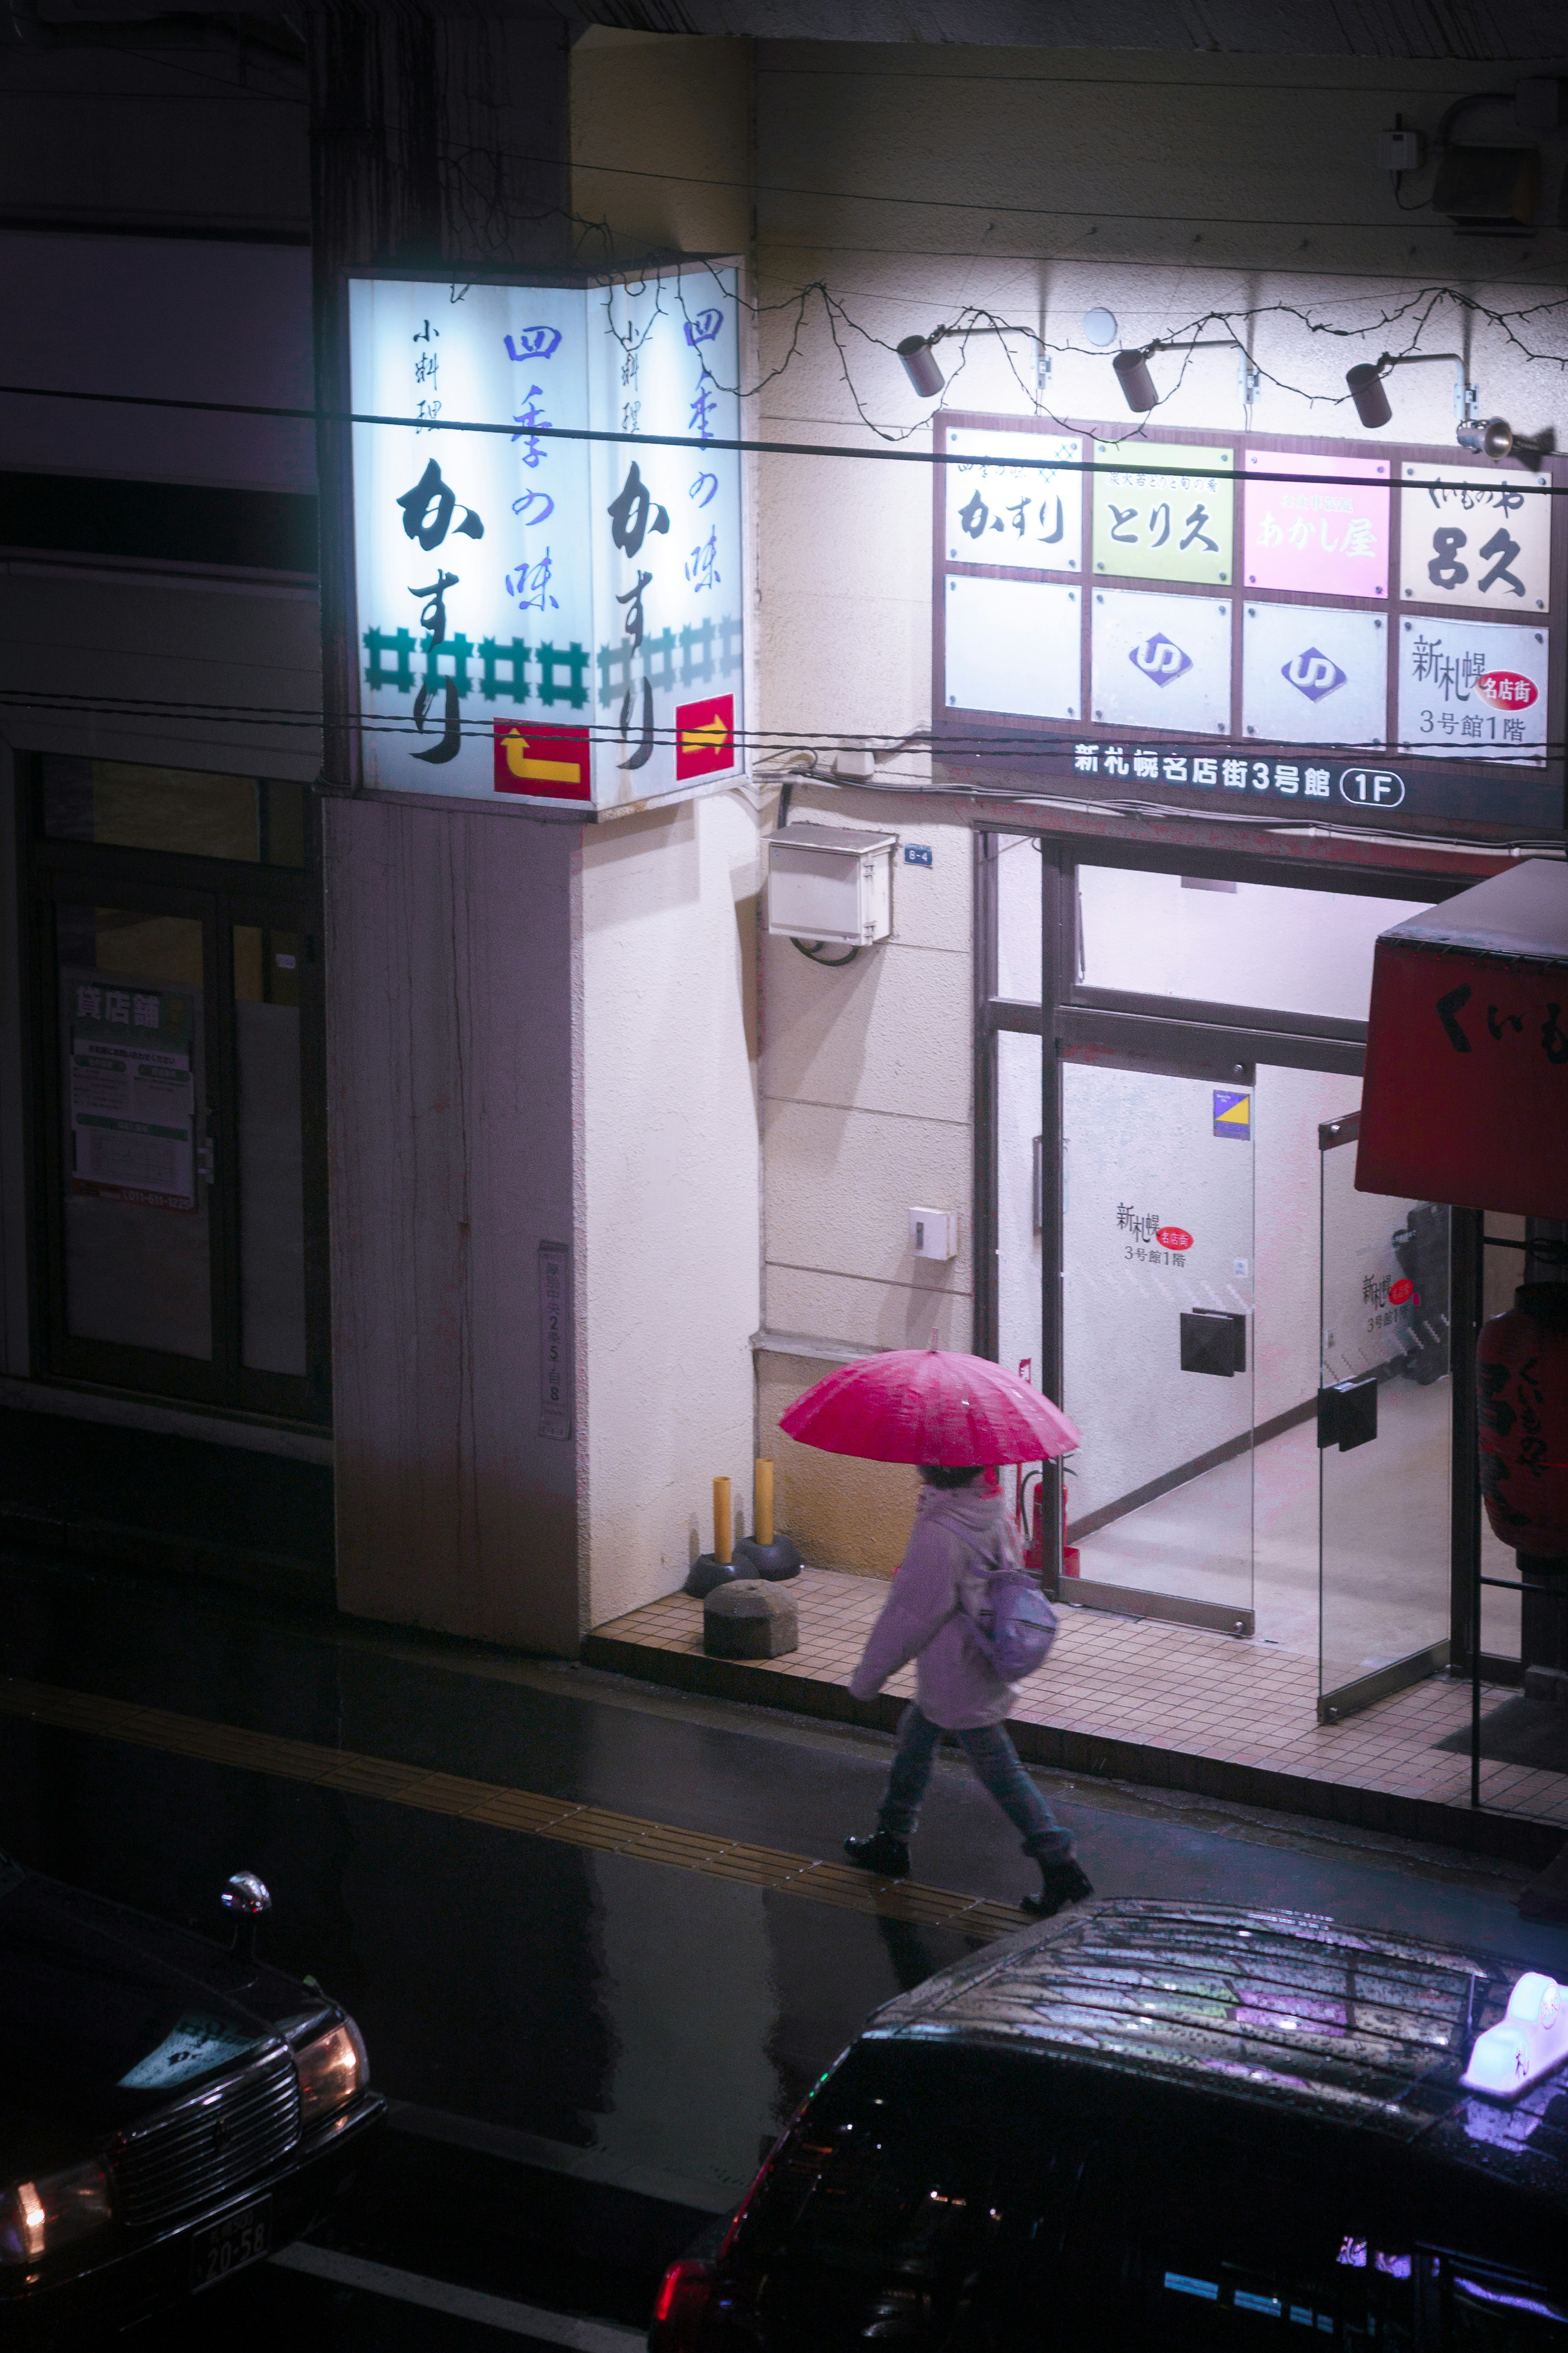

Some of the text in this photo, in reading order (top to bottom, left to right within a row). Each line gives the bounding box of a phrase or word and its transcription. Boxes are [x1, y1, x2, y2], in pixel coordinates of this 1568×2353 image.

[413, 319, 440, 435] 小料理
[620, 320, 642, 435] 小料理
[505, 326, 562, 611] 四季の味
[684, 308, 724, 592] 四季の味
[958, 489, 1063, 544] かすり
[1108, 503, 1219, 552] とり久
[1256, 511, 1378, 558] あかし屋
[1428, 526, 1526, 598] 呂久
[396, 457, 485, 764] かすり
[607, 460, 670, 770] かすり
[1420, 710, 1526, 742] 3号館1階
[1355, 773, 1392, 802] 1F
[1125, 1246, 1186, 1268] 3号館1階
